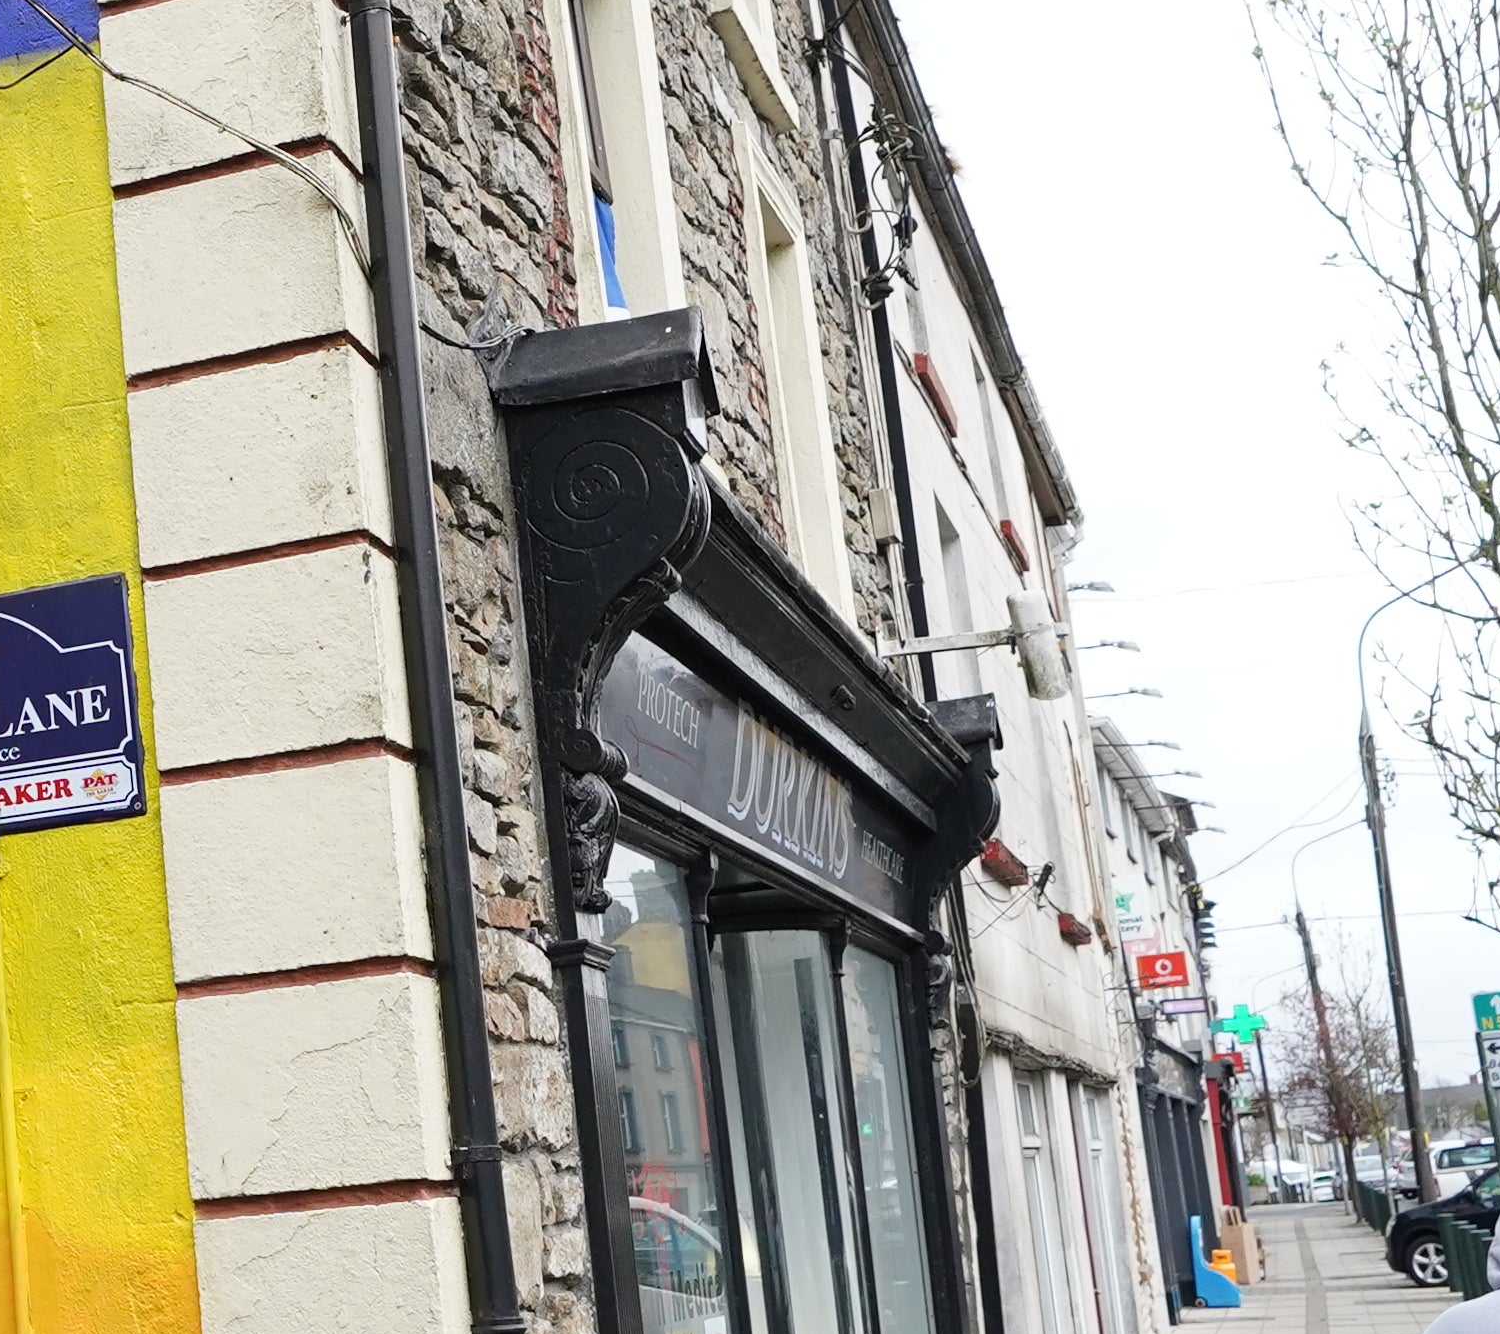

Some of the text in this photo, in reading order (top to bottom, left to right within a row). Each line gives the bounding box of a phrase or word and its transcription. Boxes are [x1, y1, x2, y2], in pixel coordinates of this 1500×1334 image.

[637, 666, 700, 749] PROTECH
[82, 773, 118, 788] PAT
[727, 698, 855, 880] DURKINS
